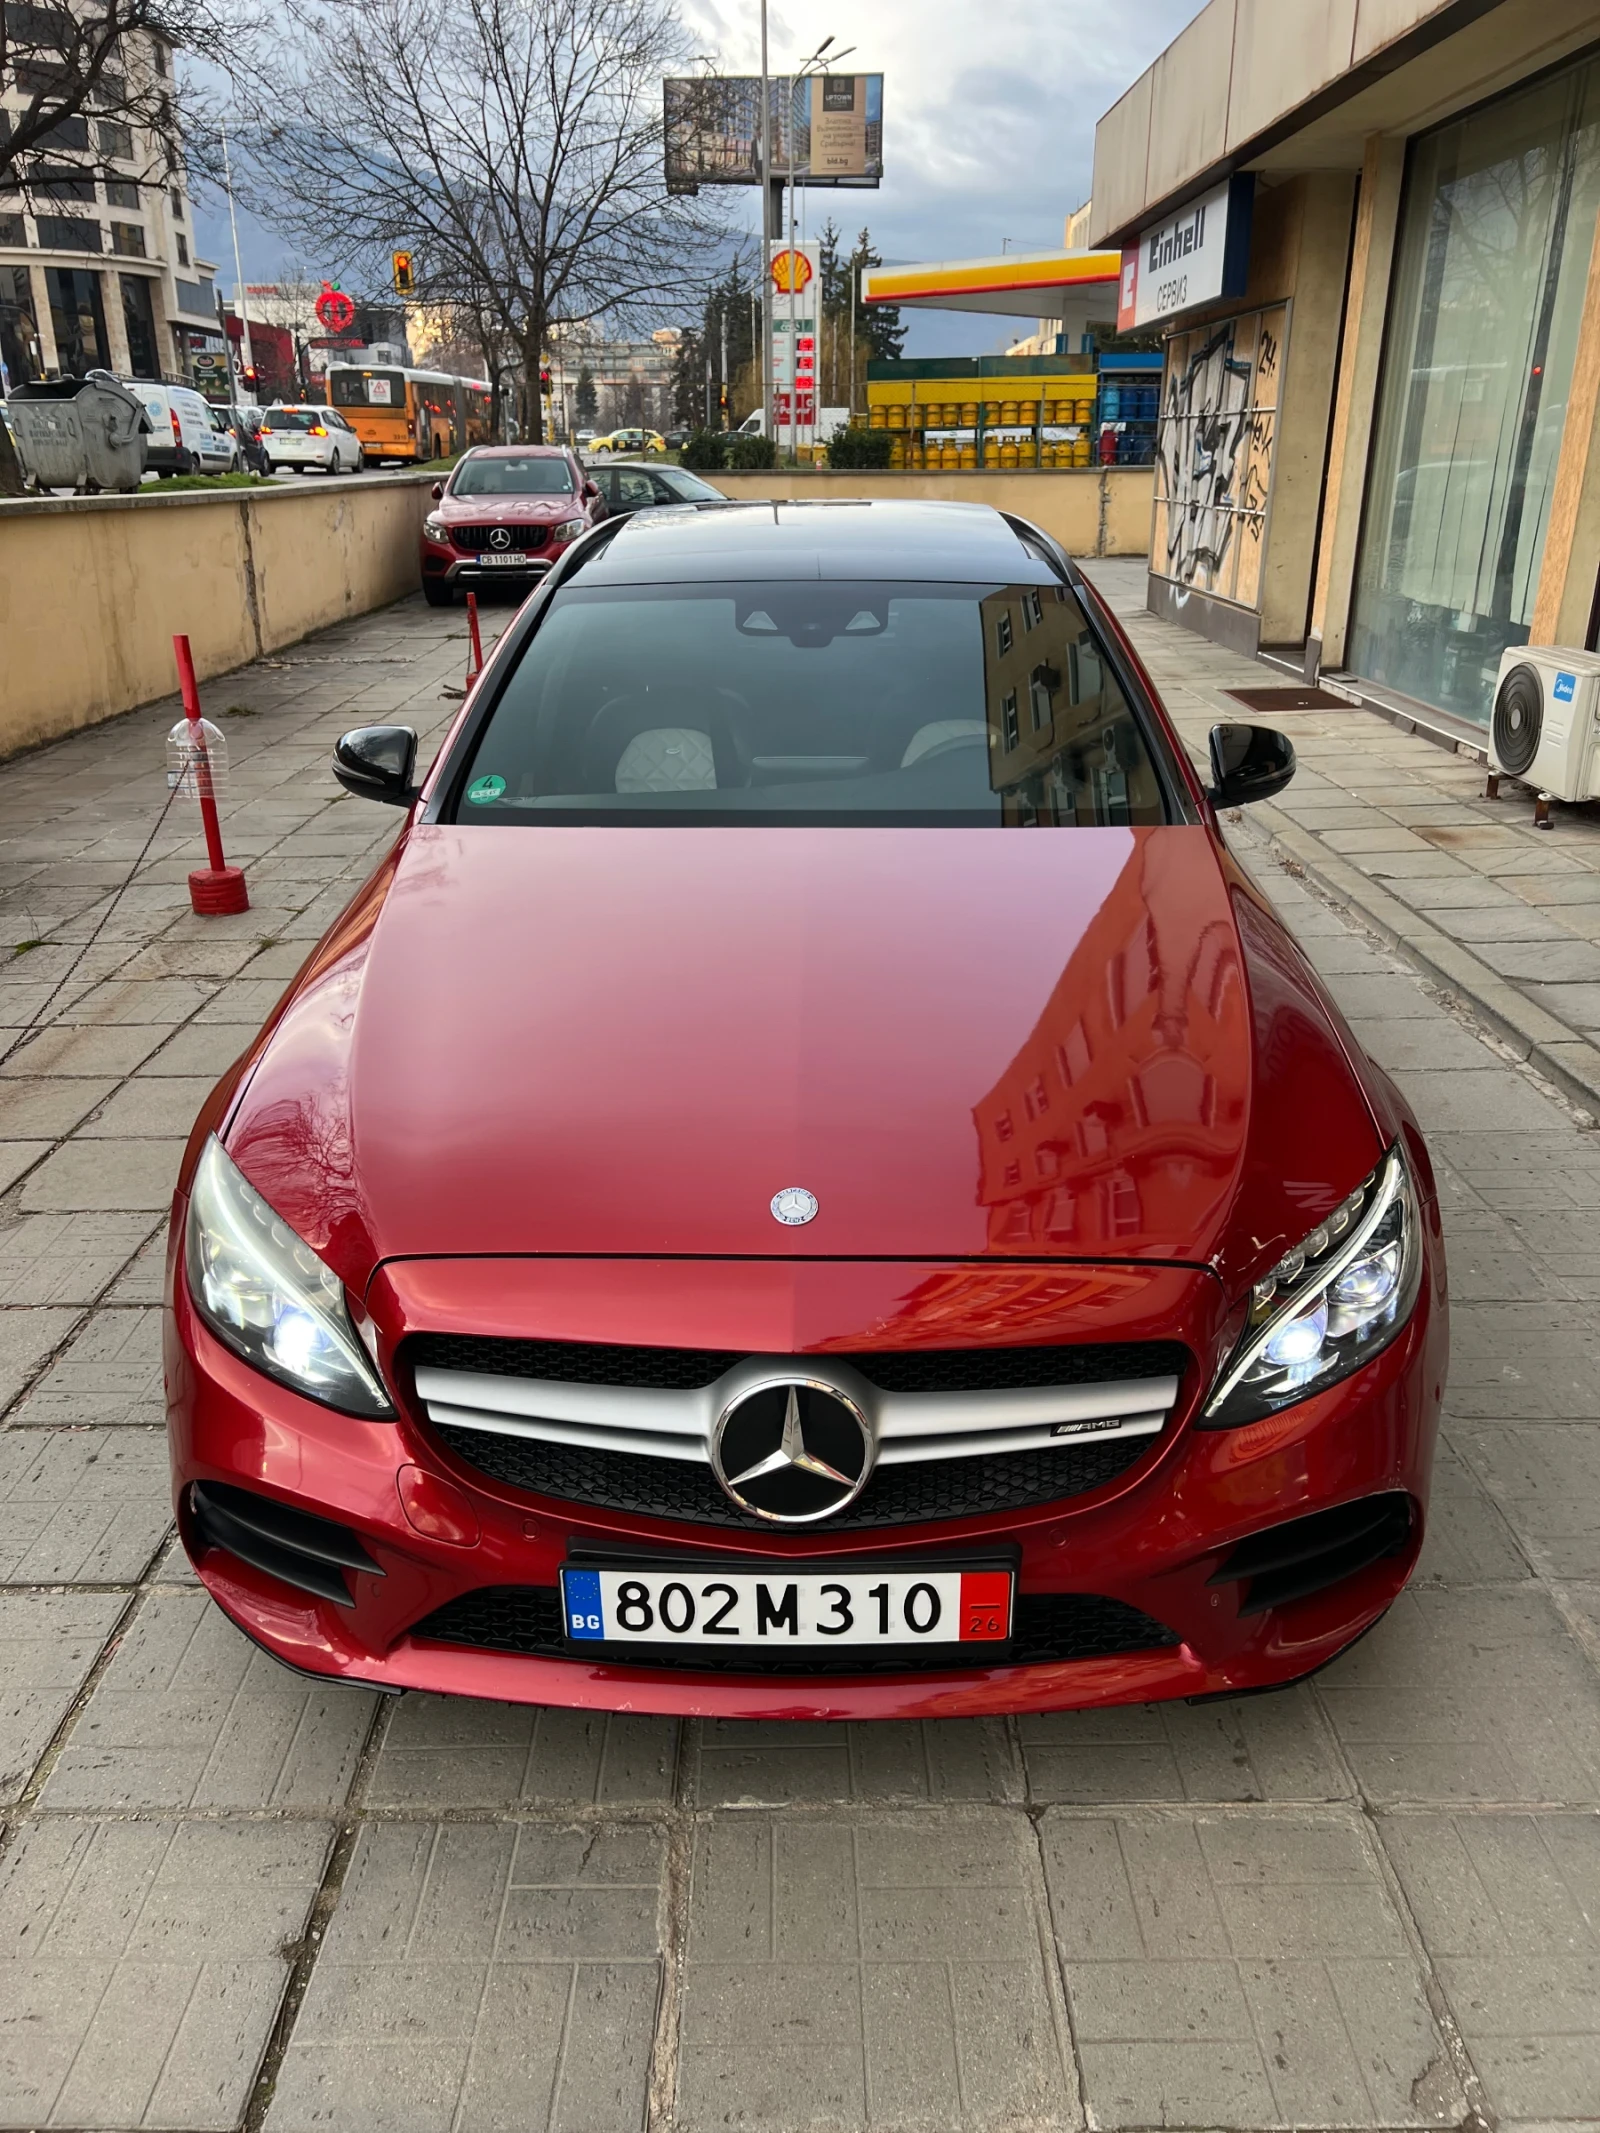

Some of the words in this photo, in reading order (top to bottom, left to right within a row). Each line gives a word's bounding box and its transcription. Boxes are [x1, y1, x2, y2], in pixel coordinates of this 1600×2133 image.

[826, 157, 849, 166] bld.bg
[1148, 205, 1206, 273] Einhell
[1157, 274, 1187, 312] СЕРВИЗ
[482, 776, 493, 788] 4
[1080, 1419, 1120, 1431] AMG
[571, 1614, 600, 1630] BG
[970, 1616, 1000, 1632] 26
